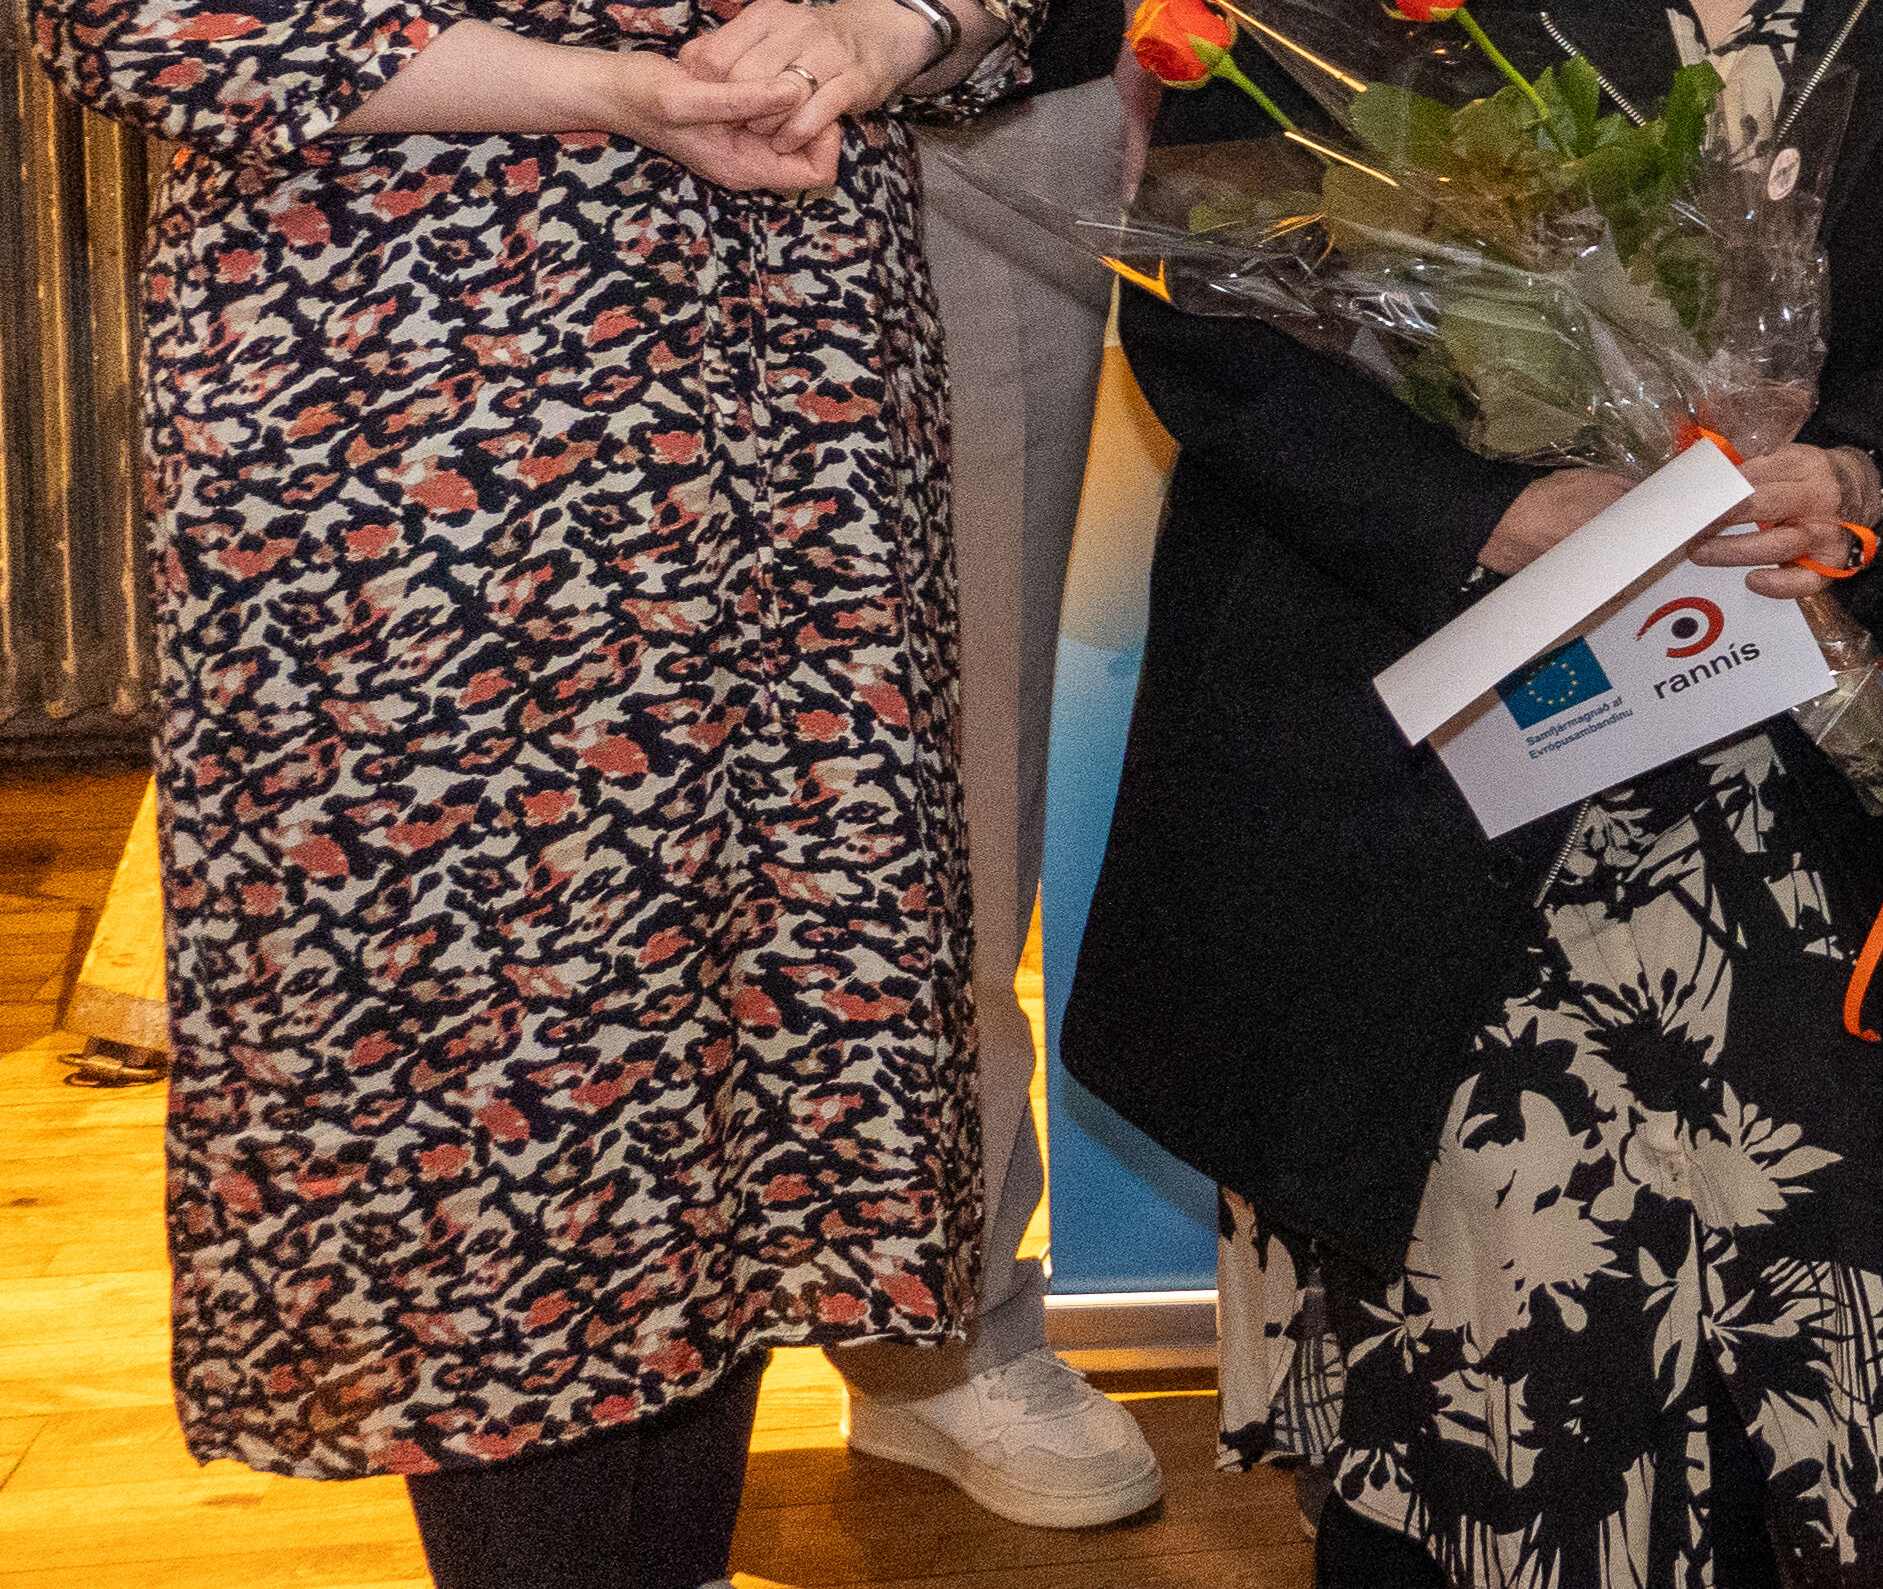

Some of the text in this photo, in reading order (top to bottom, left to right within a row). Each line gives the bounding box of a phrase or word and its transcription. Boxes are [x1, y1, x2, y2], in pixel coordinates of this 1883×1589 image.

[1654, 642, 1760, 699] rannís
[1525, 696, 1623, 747] Samfjármagnað af
[1528, 708, 1634, 760] Evrópusambandinu
